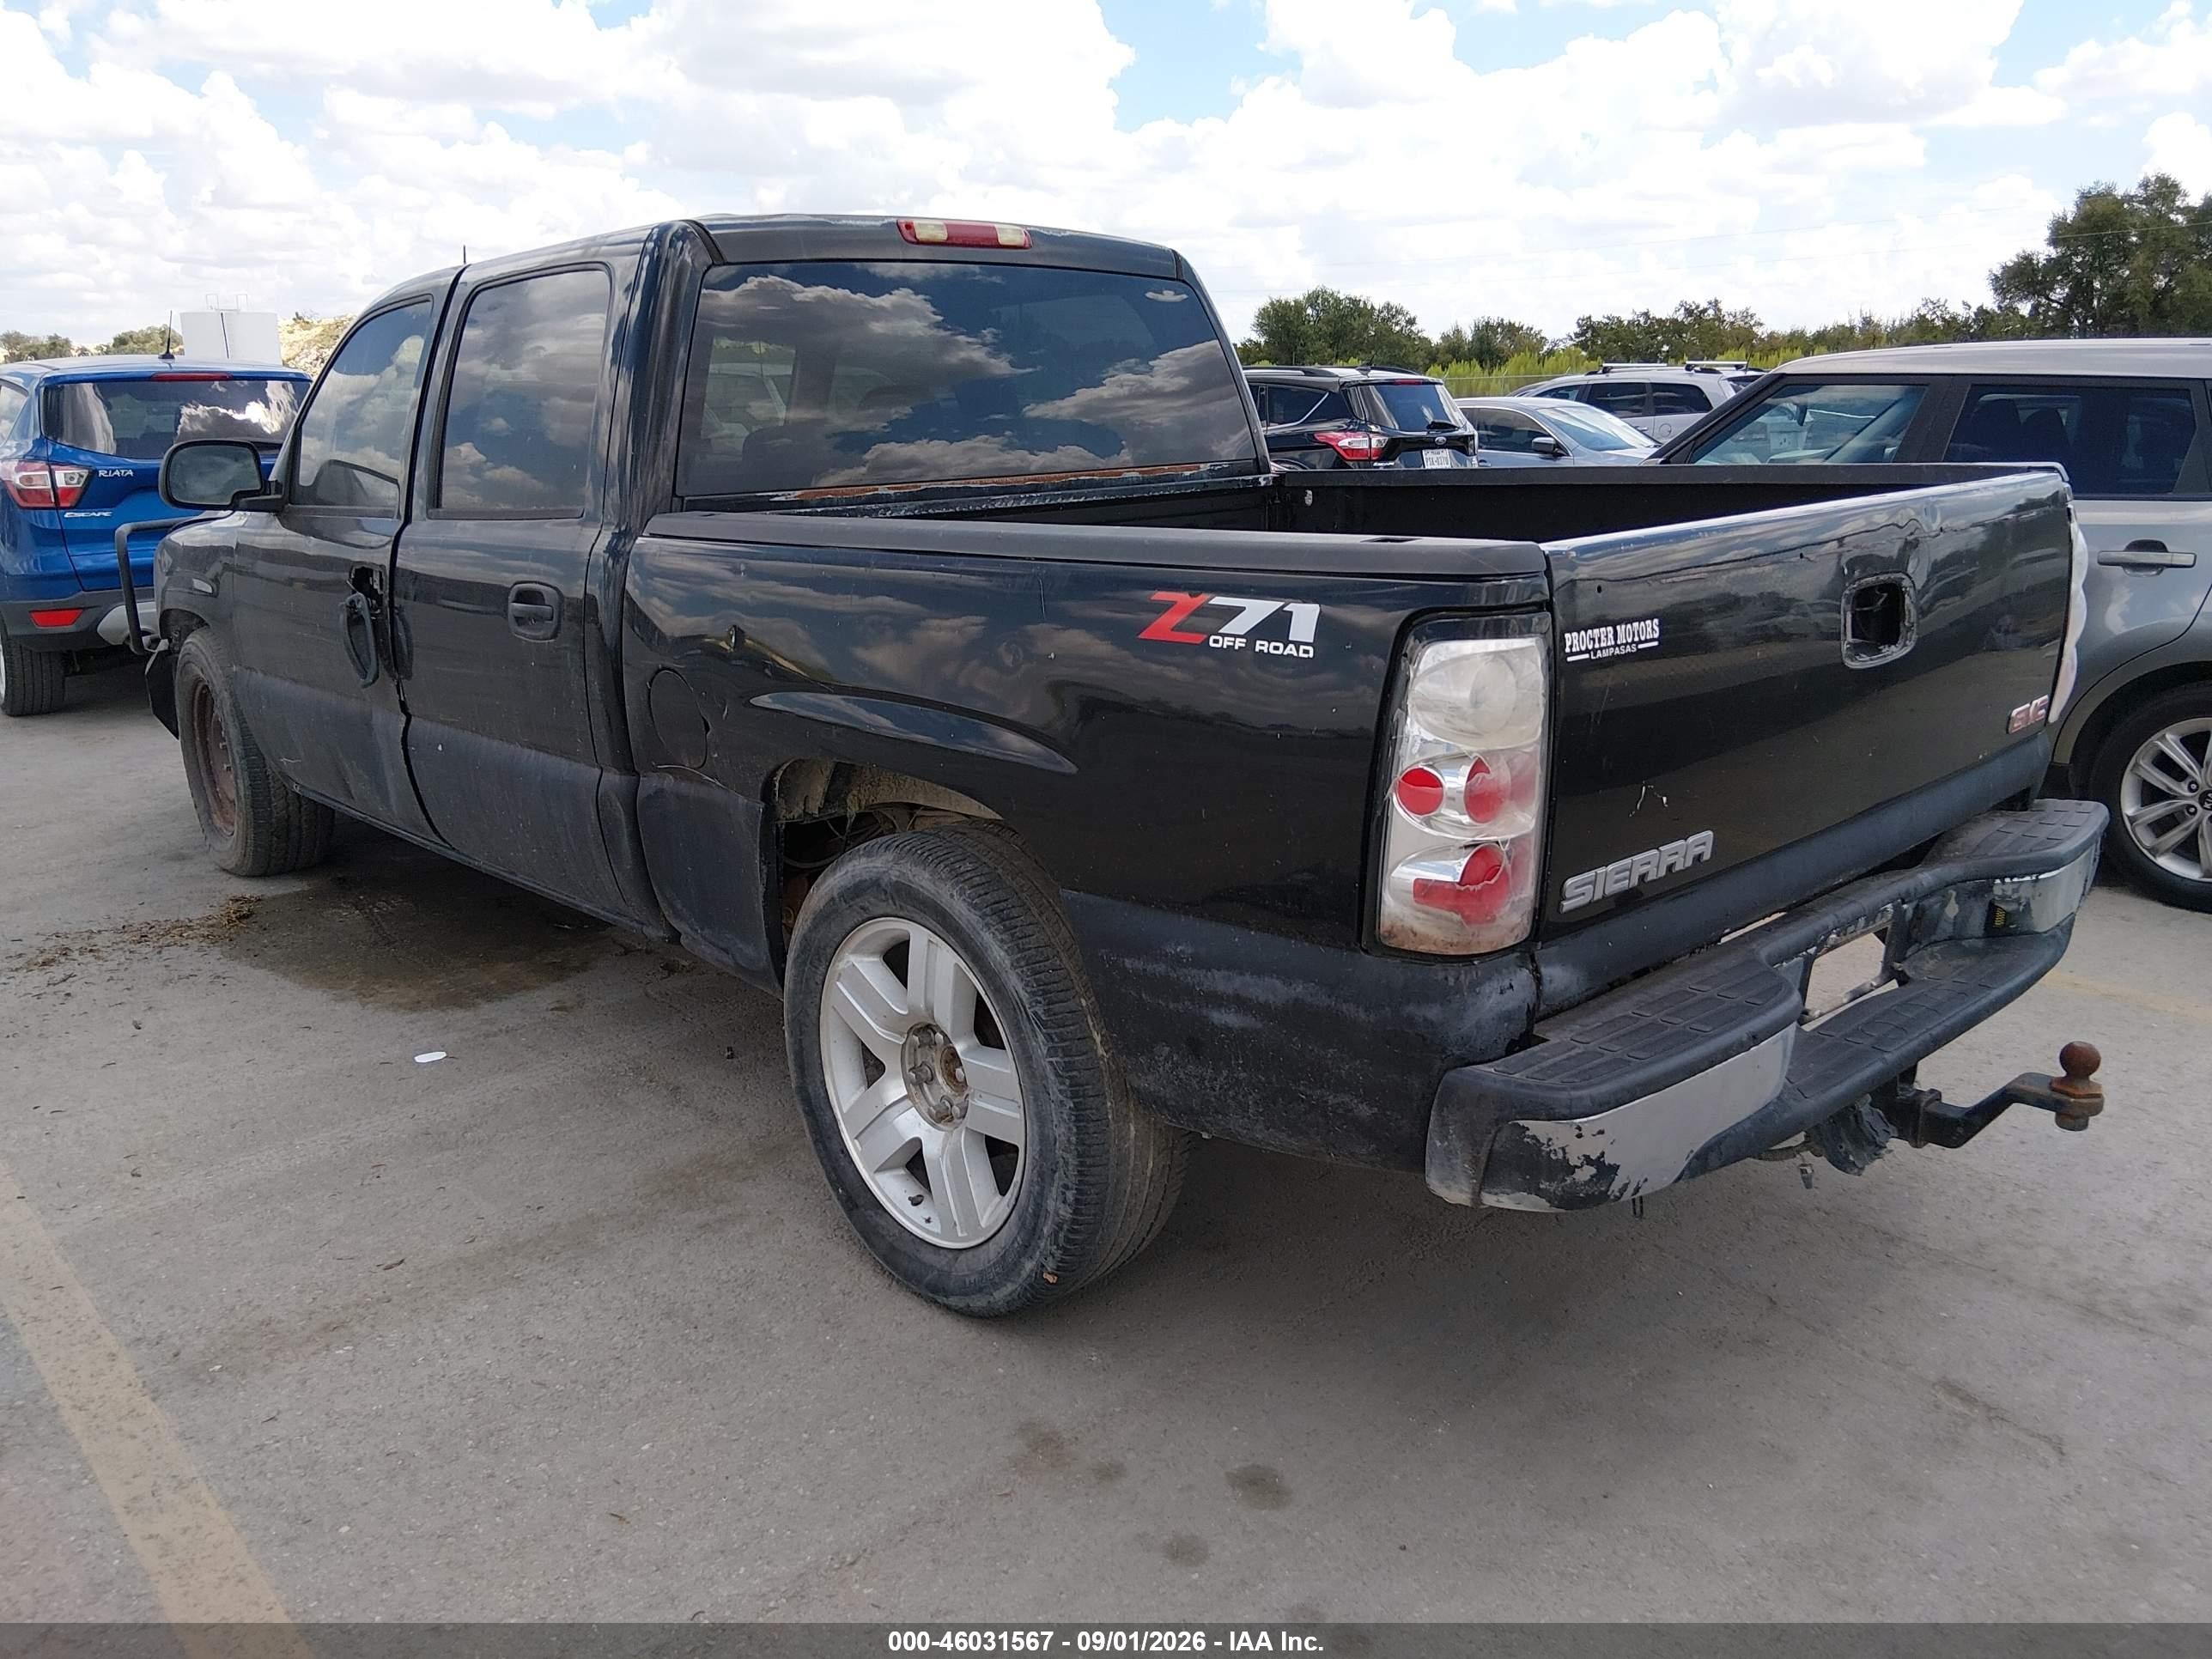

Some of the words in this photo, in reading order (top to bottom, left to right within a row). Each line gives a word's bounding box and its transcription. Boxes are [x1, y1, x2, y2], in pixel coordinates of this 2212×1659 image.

[98, 469, 134, 477] RIATA
[1137, 590, 1321, 645] Z71
[1208, 635, 1247, 650] OFF
[1255, 640, 1315, 659] ROAD
[1565, 625, 1614, 653] PROCTER
[1616, 618, 1660, 645] MOTORS
[1590, 643, 1638, 659] LAMPASAS
[1559, 830, 1714, 915] SIERRA
